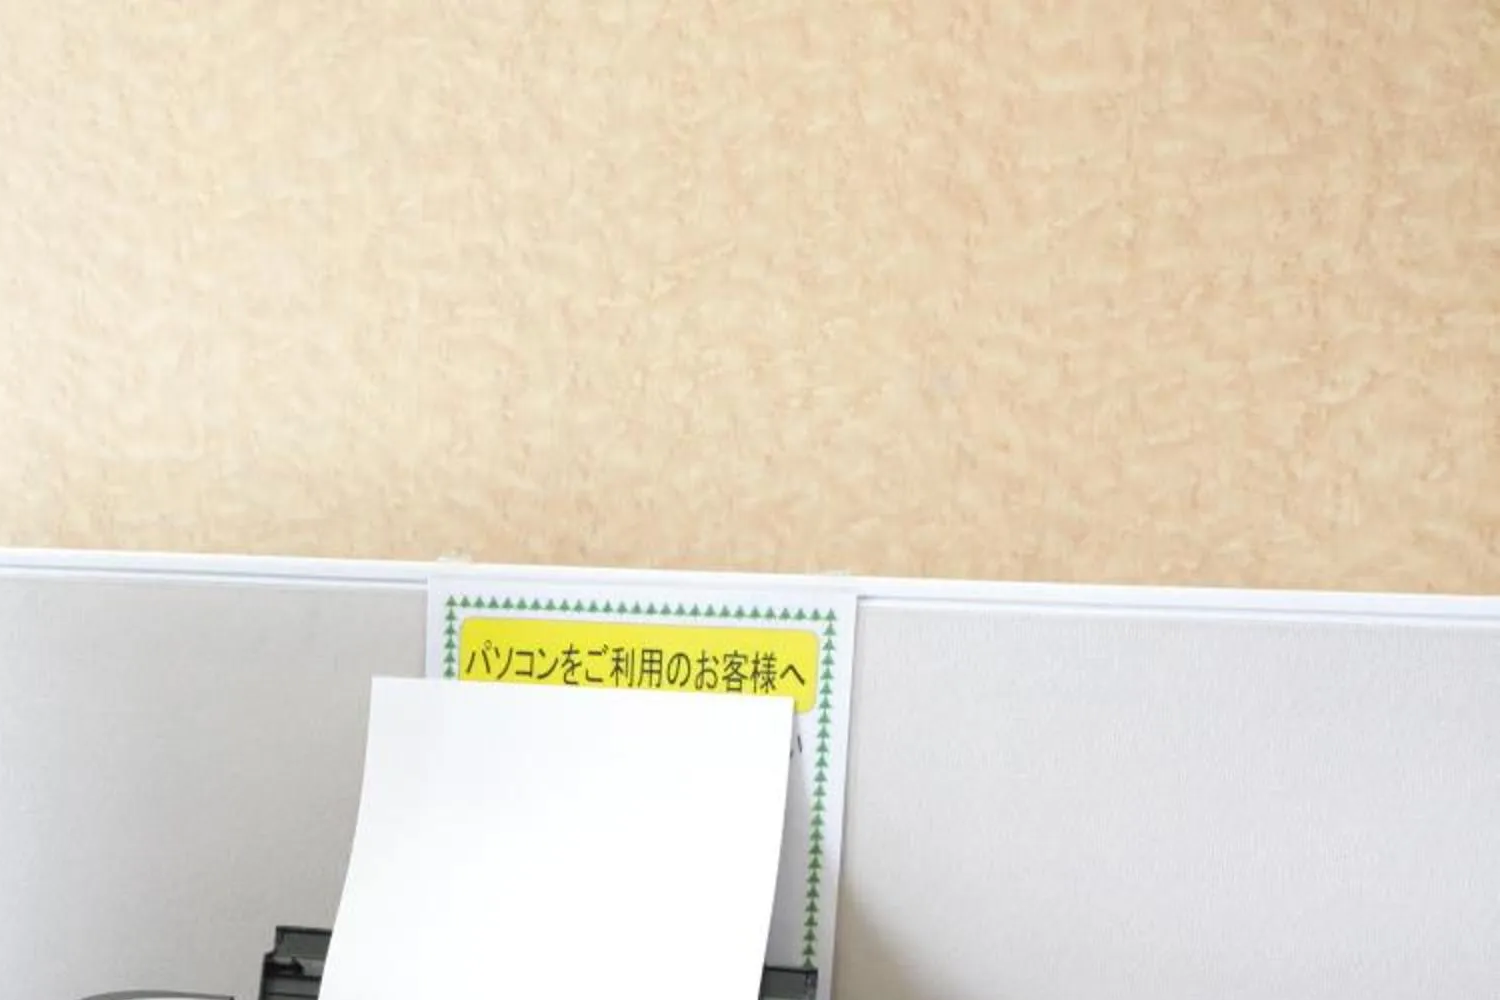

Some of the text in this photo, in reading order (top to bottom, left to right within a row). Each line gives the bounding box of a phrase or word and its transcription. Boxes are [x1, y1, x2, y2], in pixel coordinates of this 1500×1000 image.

[464, 638, 806, 694] パソコンをご利用のお客様へ
